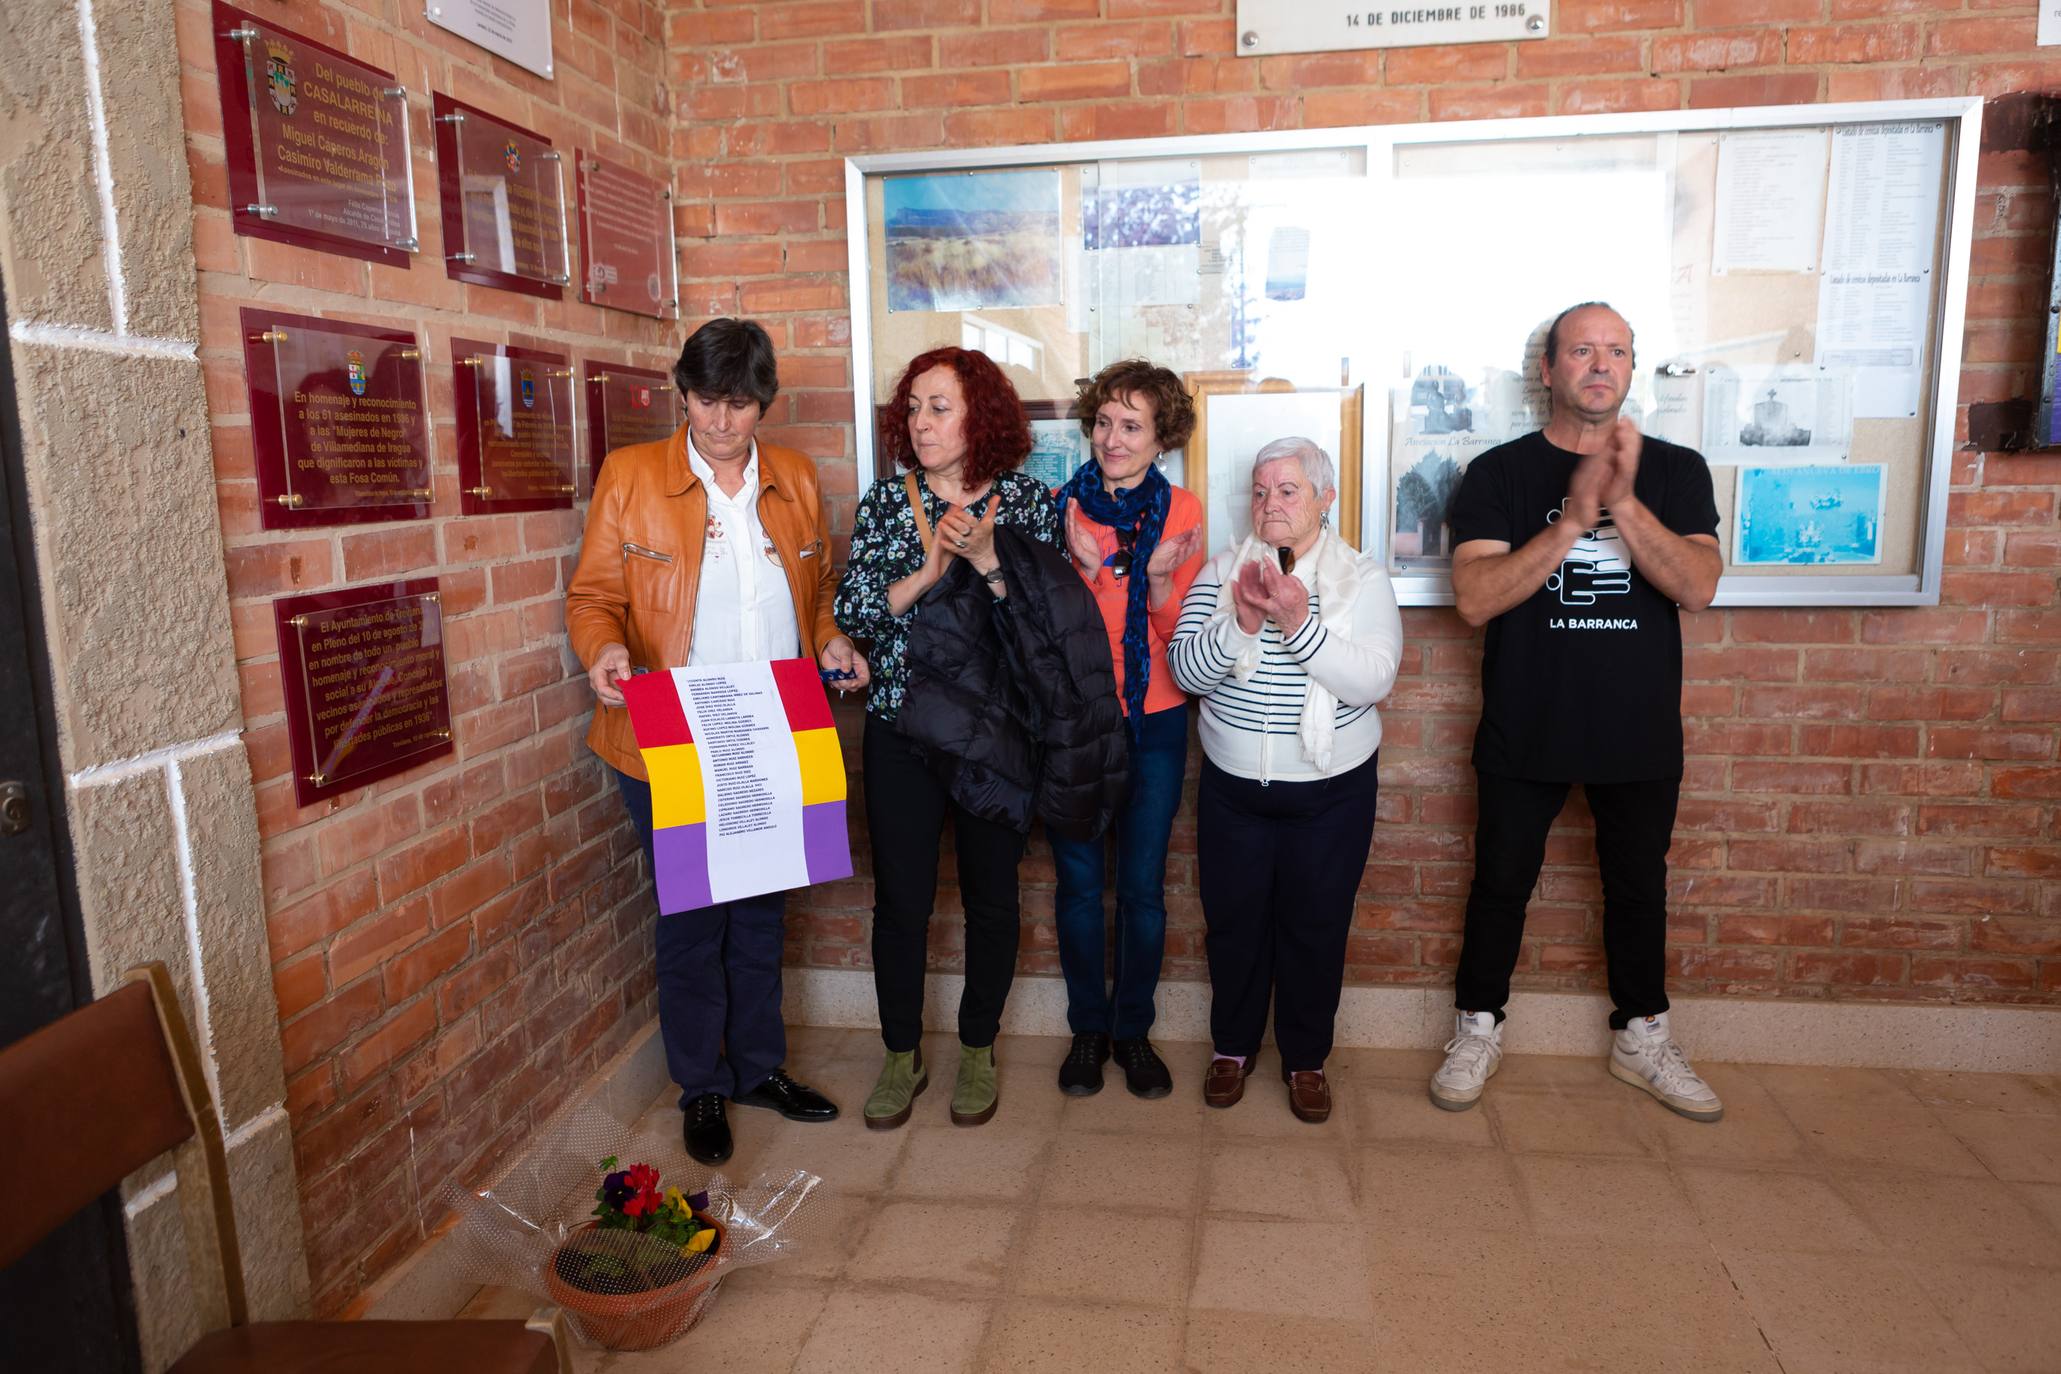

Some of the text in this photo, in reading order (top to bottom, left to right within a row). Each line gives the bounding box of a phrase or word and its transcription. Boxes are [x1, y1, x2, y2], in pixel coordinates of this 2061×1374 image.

[1346, 4, 1526, 27] 14 DE DICIEMBRE DE 1986
[315, 63, 385, 102] Del pueblo de
[313, 110, 327, 126] en
[329, 118, 372, 140] recuerdo
[282, 123, 316, 147] Miguel
[320, 135, 356, 160] Caperos
[278, 145, 321, 170] Casimiro
[323, 159, 373, 185] Valderrama
[295, 391, 417, 410] En homenaje y reconocimiento
[299, 411, 305, 420] a
[306, 409, 320, 420] los
[334, 410, 380, 422] asesinados
[381, 413, 391, 422] en
[410, 415, 416, 426] y
[310, 428, 316, 437] a
[318, 426, 330, 437] las
[370, 428, 379, 438] de
[311, 442, 321, 452] de
[323, 442, 375, 453] Villamediana
[377, 442, 386, 453] de
[298, 460, 314, 471] que
[317, 456, 364, 470] dignificaron
[367, 460, 373, 468] a
[374, 457, 386, 468] las
[388, 456, 417, 468] víctimas
[329, 474, 348, 484] esta
[349, 472, 369, 483] Fosa
[320, 621, 330, 633] El
[331, 612, 384, 633] Ayuntamiento
[1549, 618, 1638, 630] LA BARRANCA
[311, 643, 322, 652] en
[324, 636, 347, 650] Pleno
[348, 632, 360, 645] del
[383, 624, 408, 639] agosto
[308, 661, 319, 671] en
[321, 652, 351, 668] nombre
[352, 650, 363, 661] de
[364, 646, 381, 658] todo
[312, 670, 352, 687] homenaje
[325, 688, 349, 702] social
[357, 684, 366, 694] su
[316, 705, 347, 721] vecinos
[403, 717, 413, 728] en
[324, 725, 339, 739] por
